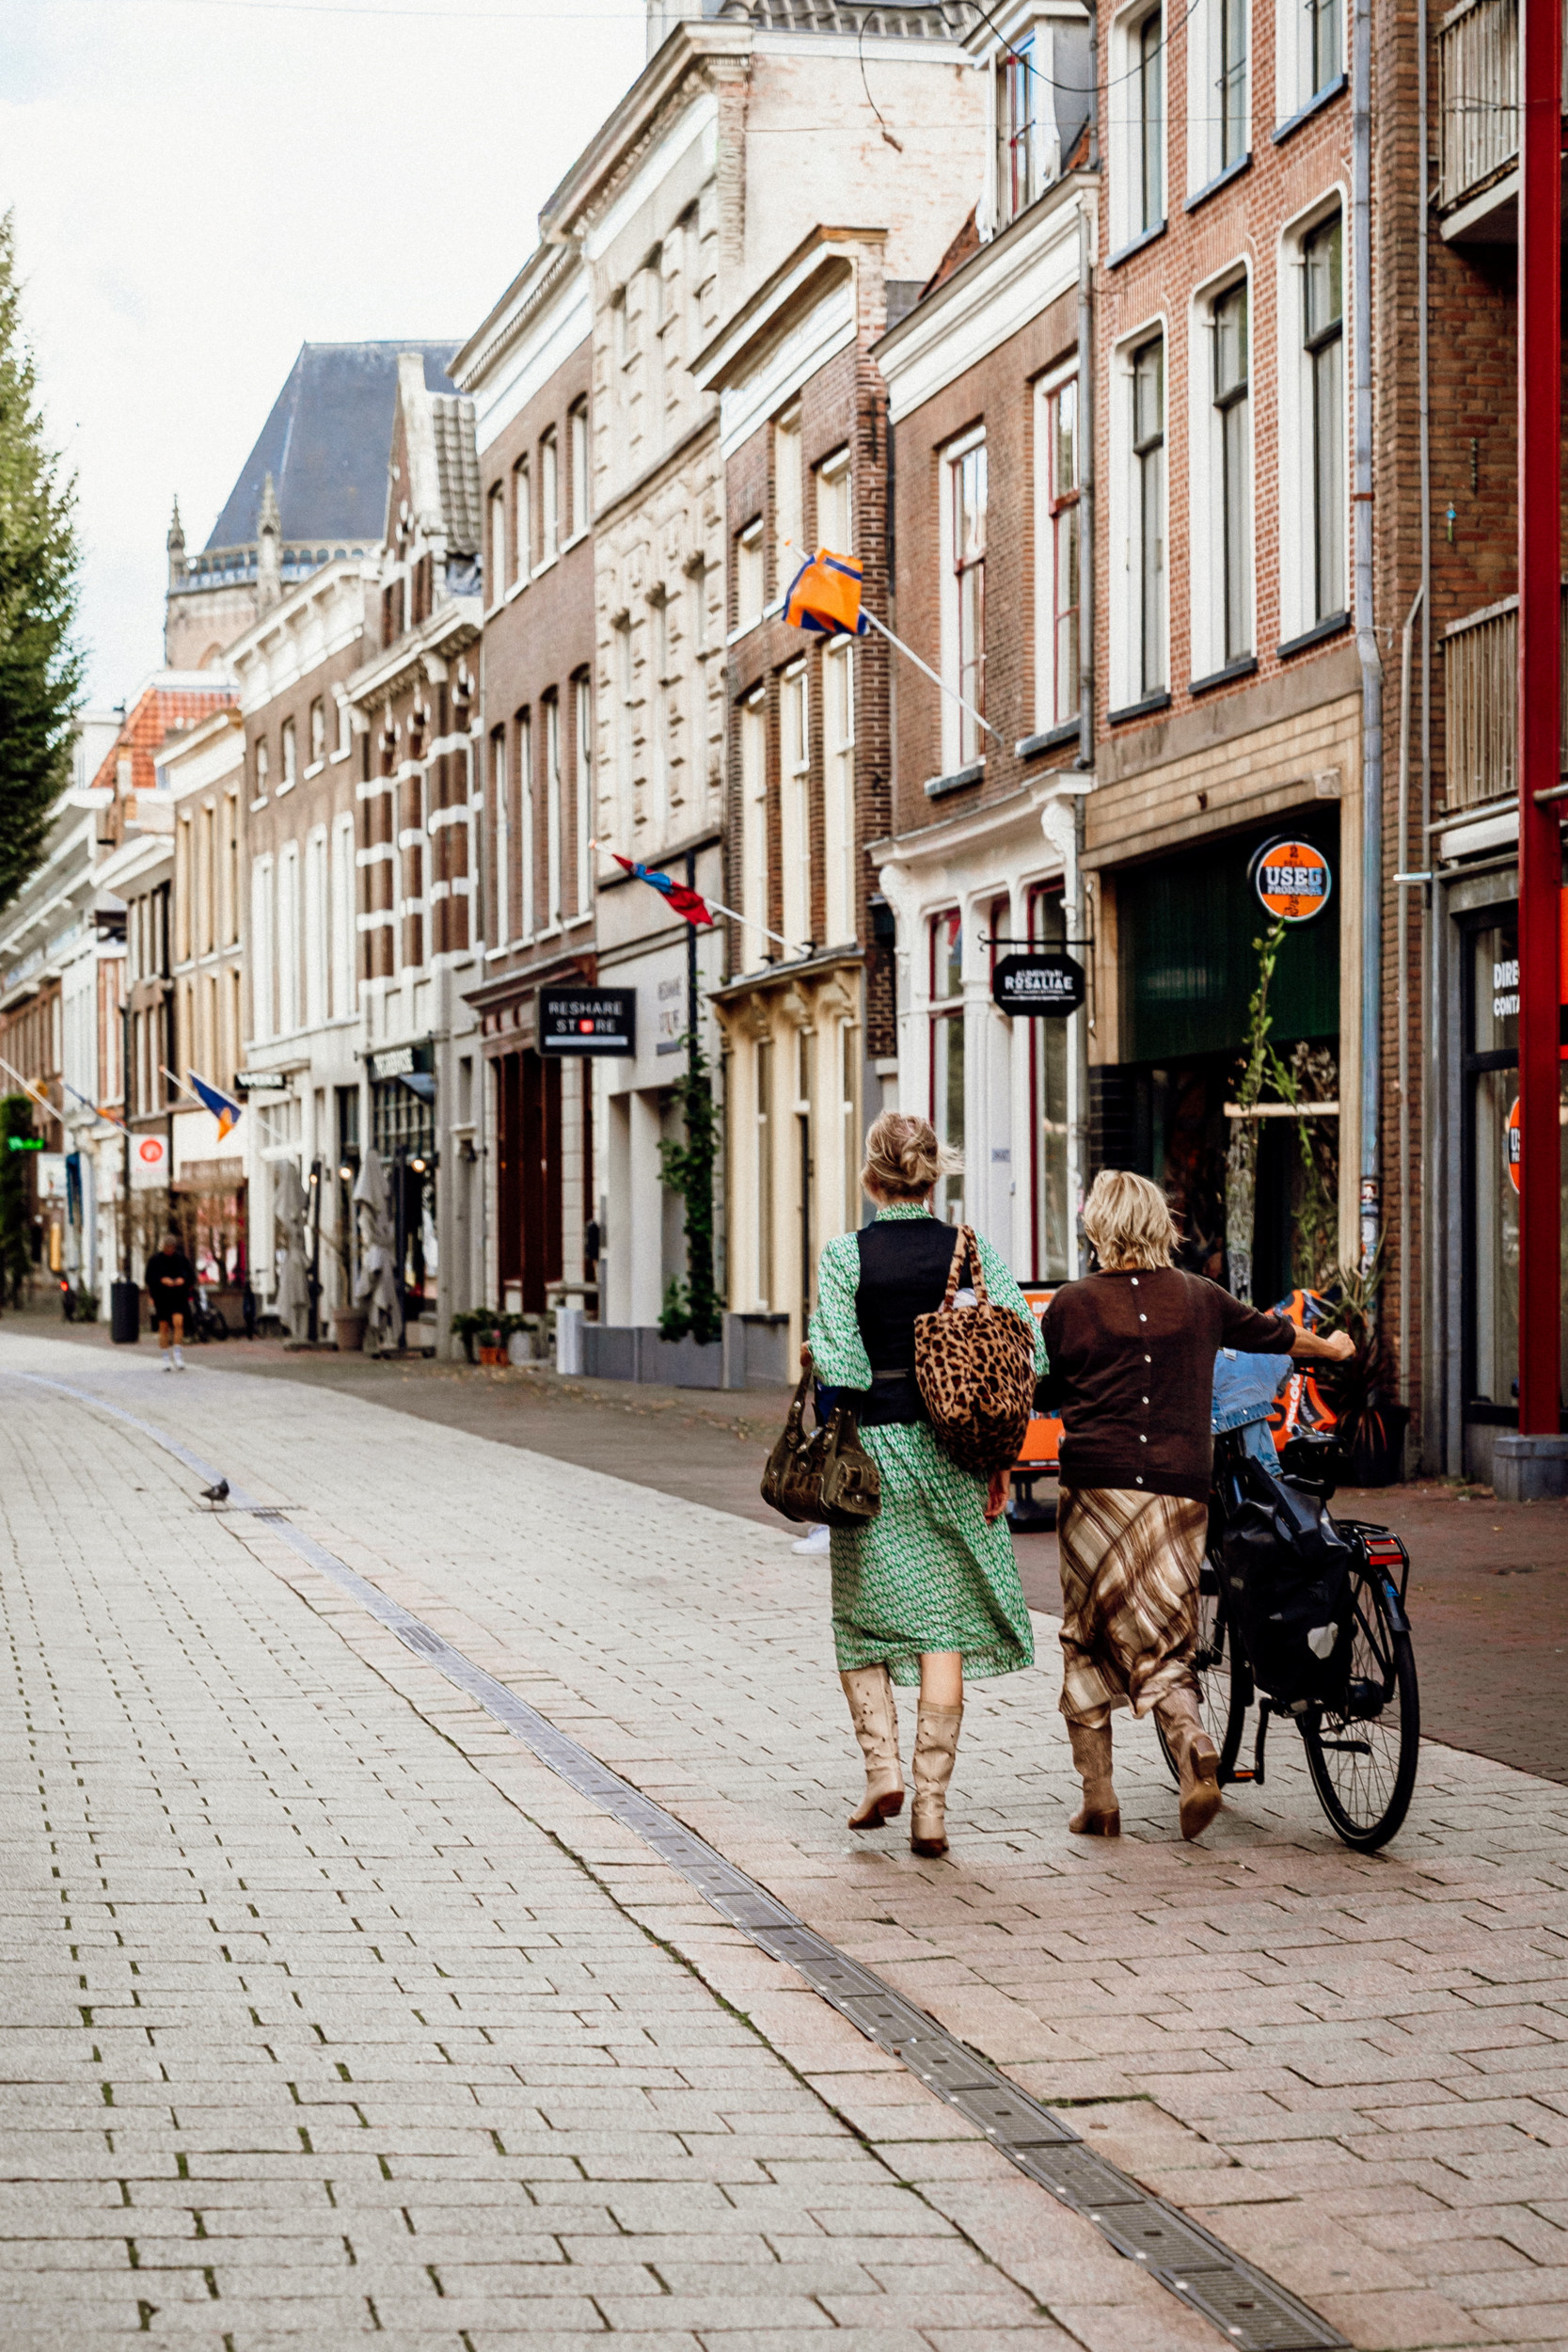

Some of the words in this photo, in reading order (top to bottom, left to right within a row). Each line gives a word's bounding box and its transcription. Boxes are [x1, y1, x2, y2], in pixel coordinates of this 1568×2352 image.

[1267, 884, 1323, 897] PROD
[1494, 960, 1520, 989] DIRE
[548, 1001, 623, 1016] RESHARE
